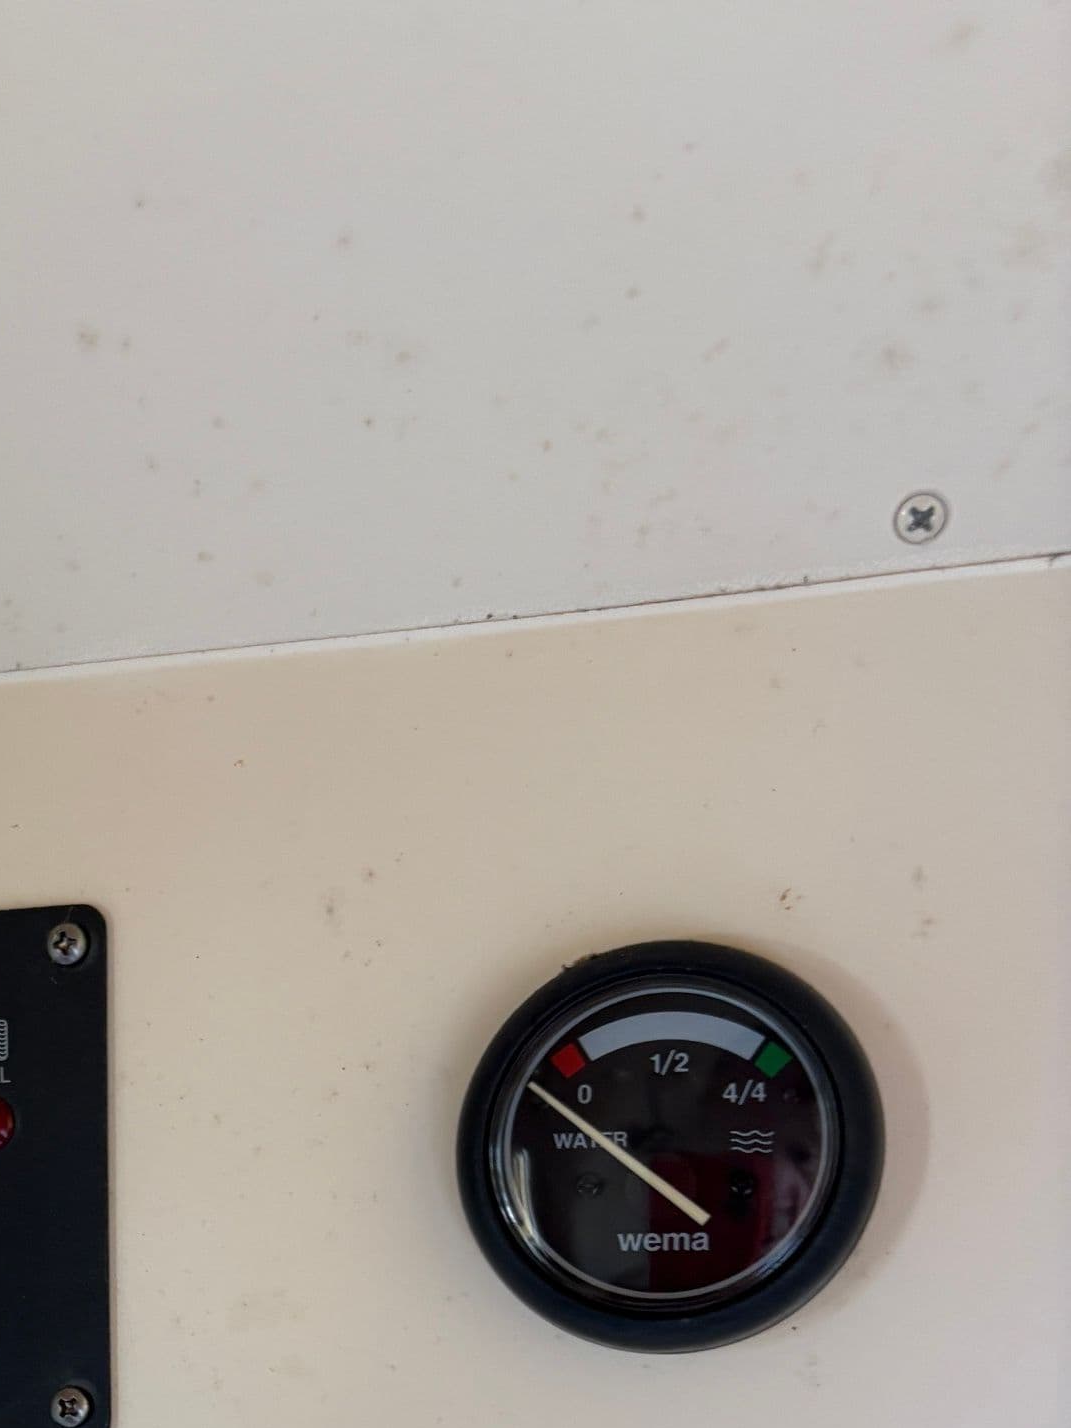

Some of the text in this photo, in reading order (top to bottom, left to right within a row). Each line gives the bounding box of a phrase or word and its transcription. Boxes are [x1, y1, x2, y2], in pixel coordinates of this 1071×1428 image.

[649, 1050, 689, 1075] 1/2
[577, 1084, 592, 1104] 0
[722, 1080, 767, 1106] 4/4
[553, 1131, 628, 1150] WAR
[617, 1232, 710, 1253] wema
